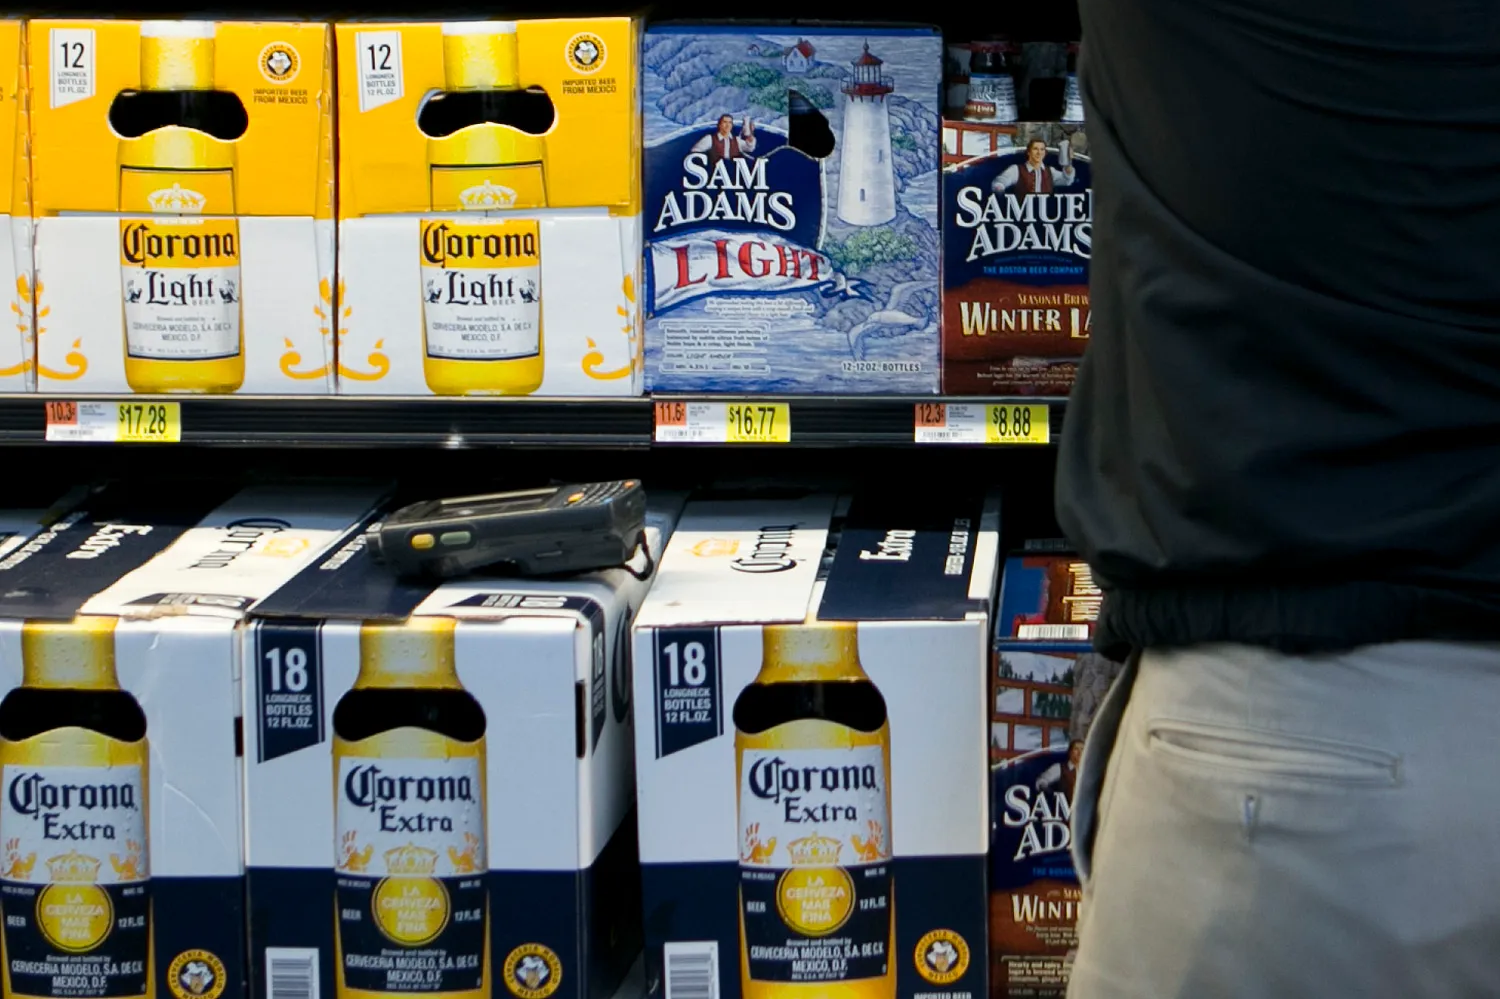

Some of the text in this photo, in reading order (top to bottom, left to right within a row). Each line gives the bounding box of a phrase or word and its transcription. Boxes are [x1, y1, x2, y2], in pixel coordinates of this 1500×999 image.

[60, 43, 85, 68] 12
[367, 44, 392, 71] 12
[366, 80, 396, 88] BOTTLES
[563, 85, 617, 95] FROM MEXICO
[682, 153, 769, 191] SAM
[654, 192, 796, 232] ADAMS
[956, 187, 1092, 229] SAMUE
[123, 223, 236, 268] Corona
[423, 222, 536, 268] Corona
[966, 224, 1091, 262] ADAMS
[675, 240, 825, 289] LIGHT
[984, 266, 1084, 274] THE BOSTON BEER COMPANY
[145, 270, 215, 305] Light
[445, 270, 515, 305] Light
[1018, 293, 1061, 306] SEASONAL
[960, 301, 1062, 336] WINTER
[120, 405, 166, 434] $17.28
[729, 407, 775, 437] $16.77
[993, 407, 1032, 437] $8.88
[266, 648, 308, 692] 18
[663, 642, 707, 686] 18
[664, 689, 711, 698] LONGNECK
[665, 700, 711, 711] BOTTLES
[266, 704, 313, 716] BOTTLES
[345, 764, 473, 812] Corona
[749, 756, 876, 803] Corona
[9, 772, 134, 820] Corona
[783, 797, 857, 823] Extra
[43, 813, 116, 841] Extra
[379, 805, 453, 833] Extra
[381, 897, 440, 910] CERVEZA
[786, 887, 845, 899] CERVEZA
[801, 912, 832, 923] FINA
